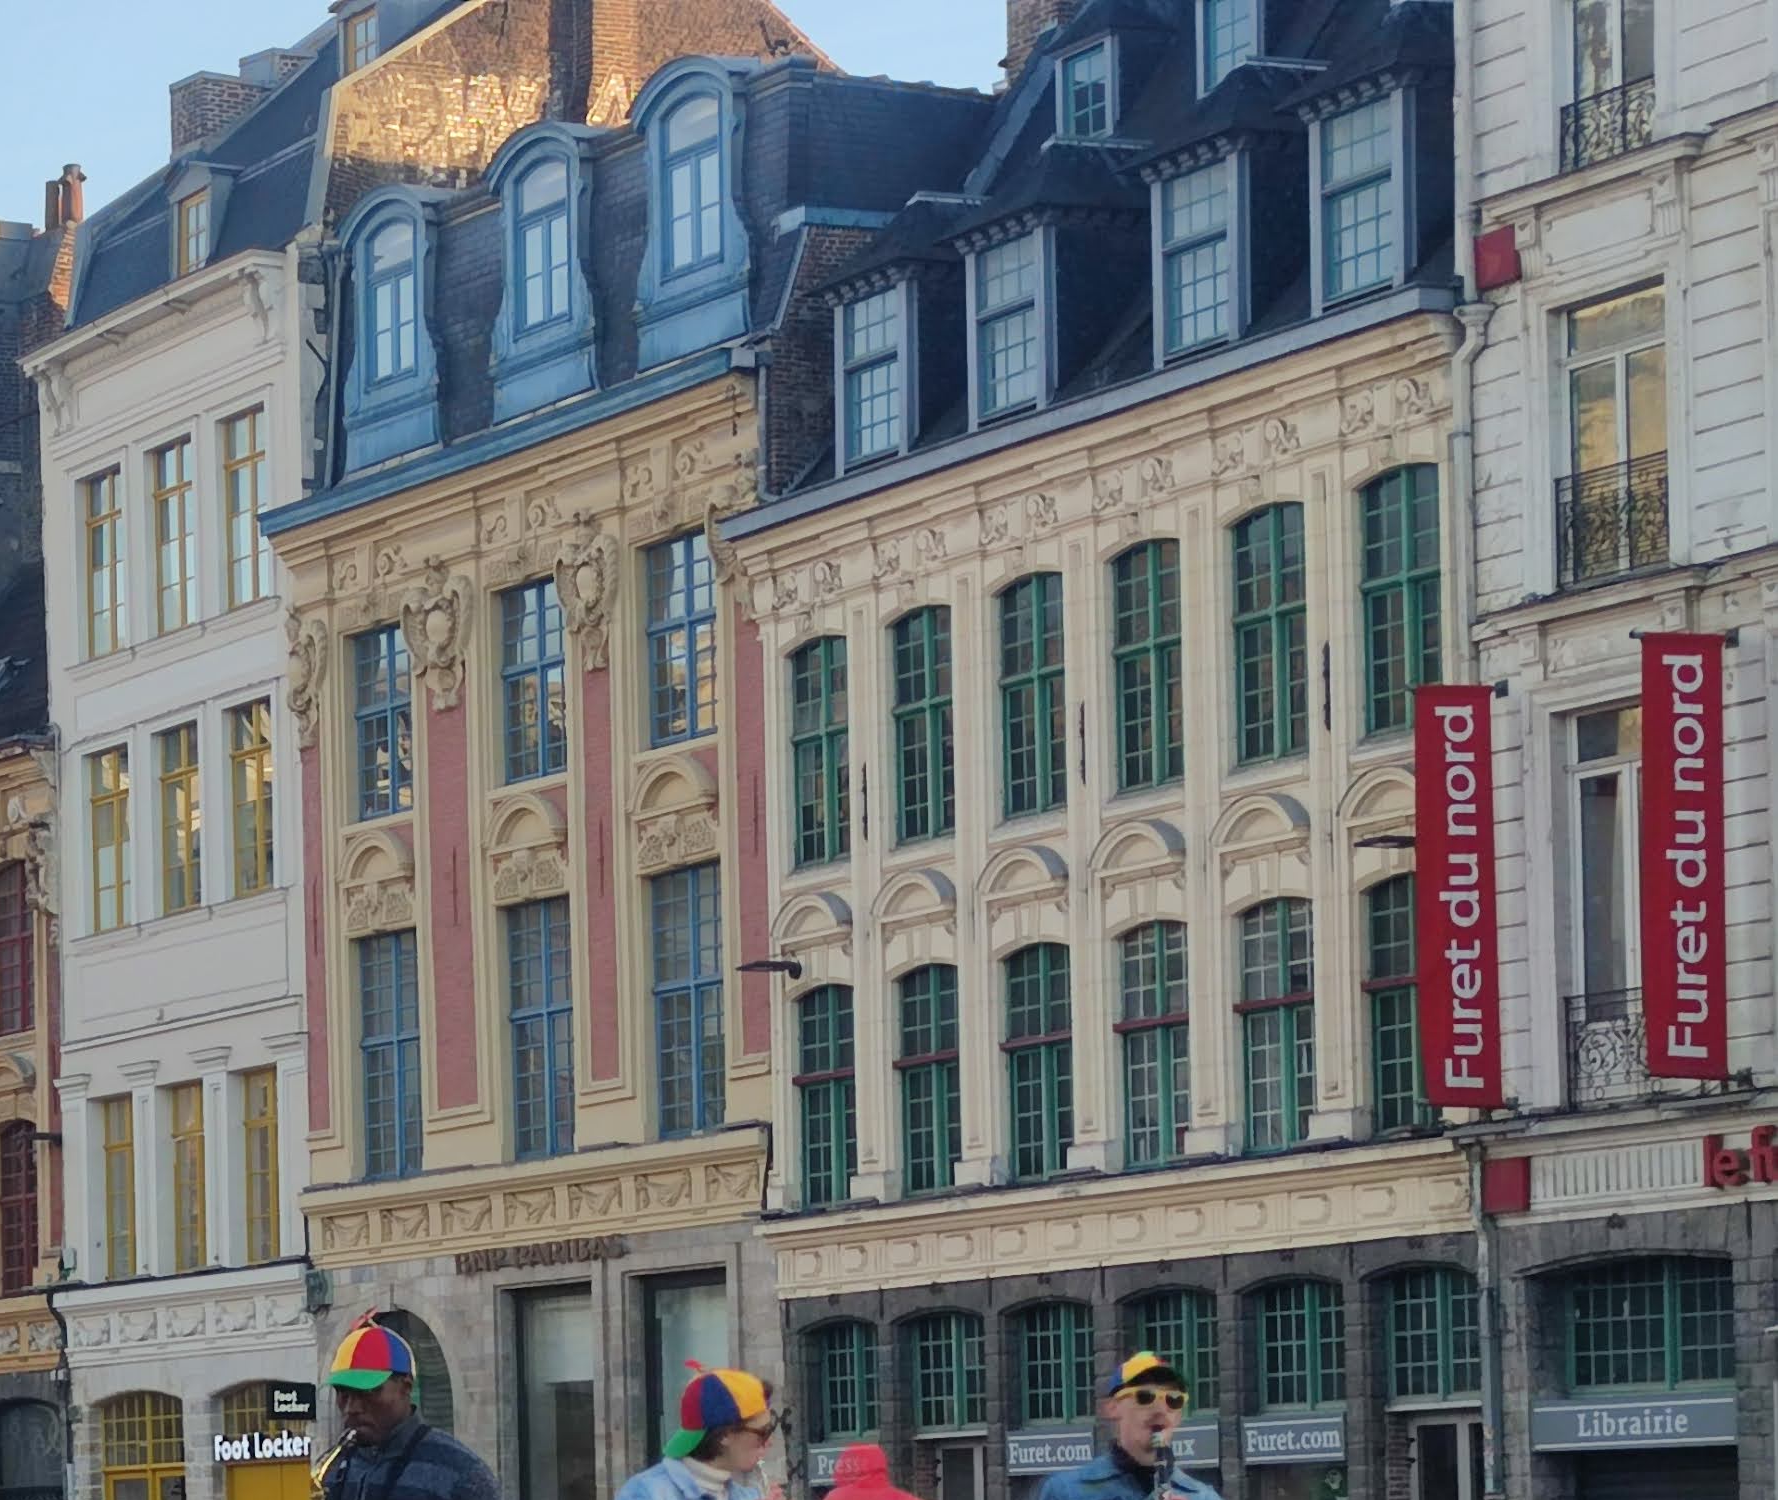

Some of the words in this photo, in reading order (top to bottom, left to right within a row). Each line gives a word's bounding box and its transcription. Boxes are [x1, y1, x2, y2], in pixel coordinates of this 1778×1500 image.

[1662, 654, 1704, 792] nord
[1435, 705, 1477, 837] nord
[1665, 809, 1706, 888] du
[1439, 853, 1480, 928] du
[1445, 938, 1484, 1089] Furet
[1667, 900, 1708, 1059] Furet
[1703, 1134, 1747, 1187] le
[214, 1433, 250, 1461] Foot
[253, 1430, 311, 1459] Locker
[1008, 1443, 1093, 1465] Furet.com
[1247, 1429, 1341, 1453] Furet.com
[1577, 1408, 1689, 1437] Librairie
